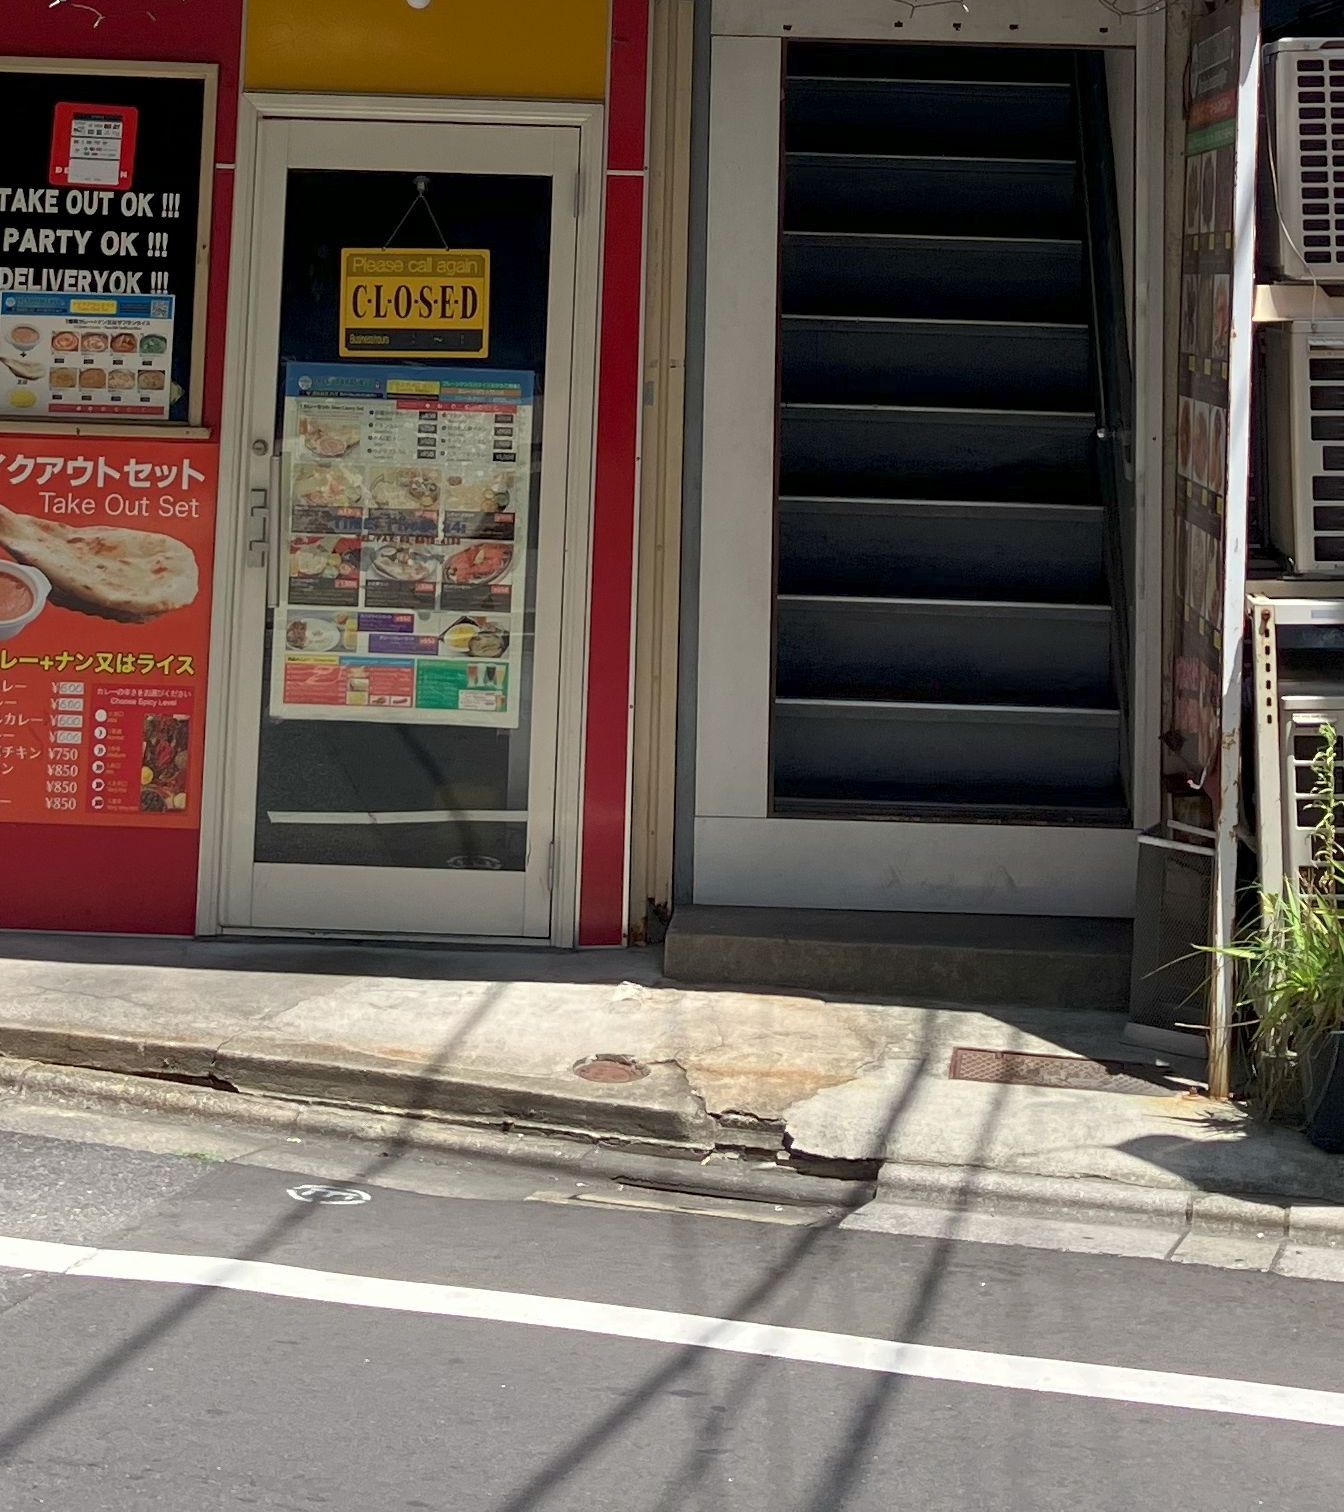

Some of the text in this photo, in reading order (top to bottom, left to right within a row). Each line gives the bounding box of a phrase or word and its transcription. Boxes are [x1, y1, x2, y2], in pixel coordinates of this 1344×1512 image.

[66, 190, 114, 215] OUT
[121, 192, 155, 217] OK
[2, 227, 93, 255] PARTY
[100, 231, 140, 256] OK
[352, 256, 478, 276] Please call again
[39, 492, 200, 518] Take Out Set
[48, 747, 79, 761] ¥750
[47, 764, 79, 777] ¥850
[46, 780, 78, 794] ¥850
[45, 796, 77, 810] ¥850
